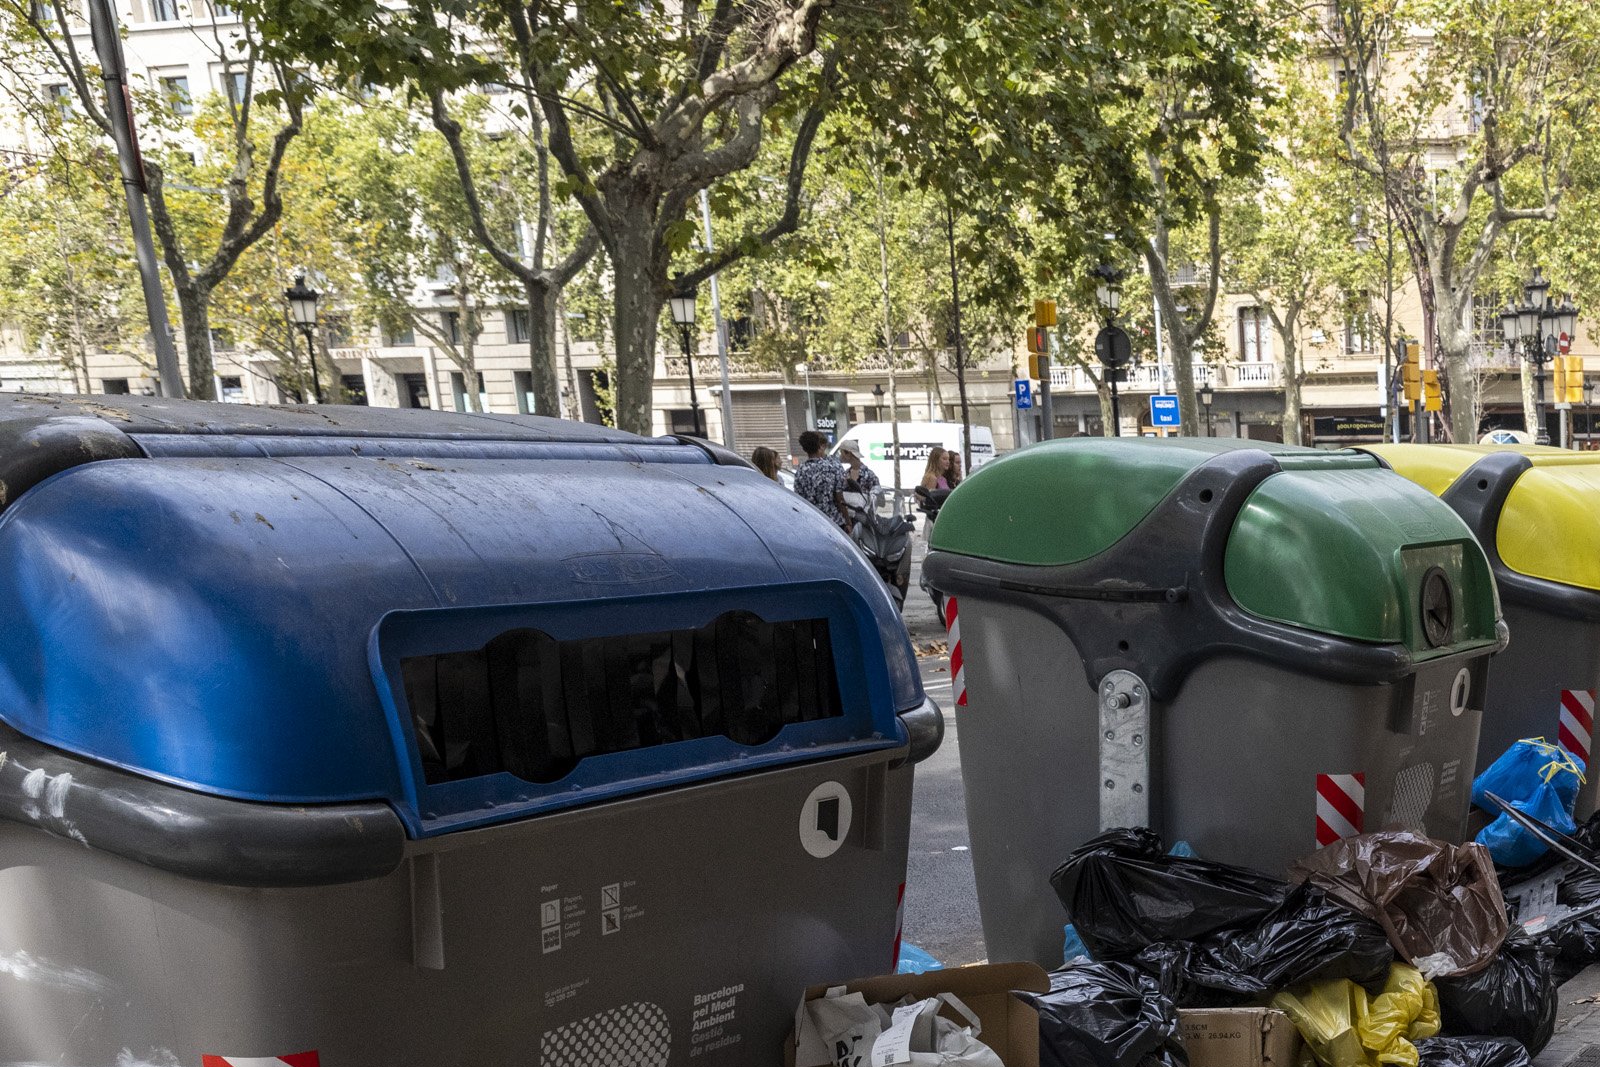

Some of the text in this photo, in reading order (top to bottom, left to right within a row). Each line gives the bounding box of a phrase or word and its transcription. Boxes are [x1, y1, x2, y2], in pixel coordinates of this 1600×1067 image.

[1018, 384, 1026, 394] P
[817, 416, 834, 428] saba
[1160, 414, 1173, 422] taxi
[694, 983, 744, 1006] Barcelona
[692, 996, 736, 1022] pel Medi
[691, 1009, 736, 1032] Ambient
[690, 1028, 724, 1045] Gestió
[690, 1034, 742, 1058] de residus
